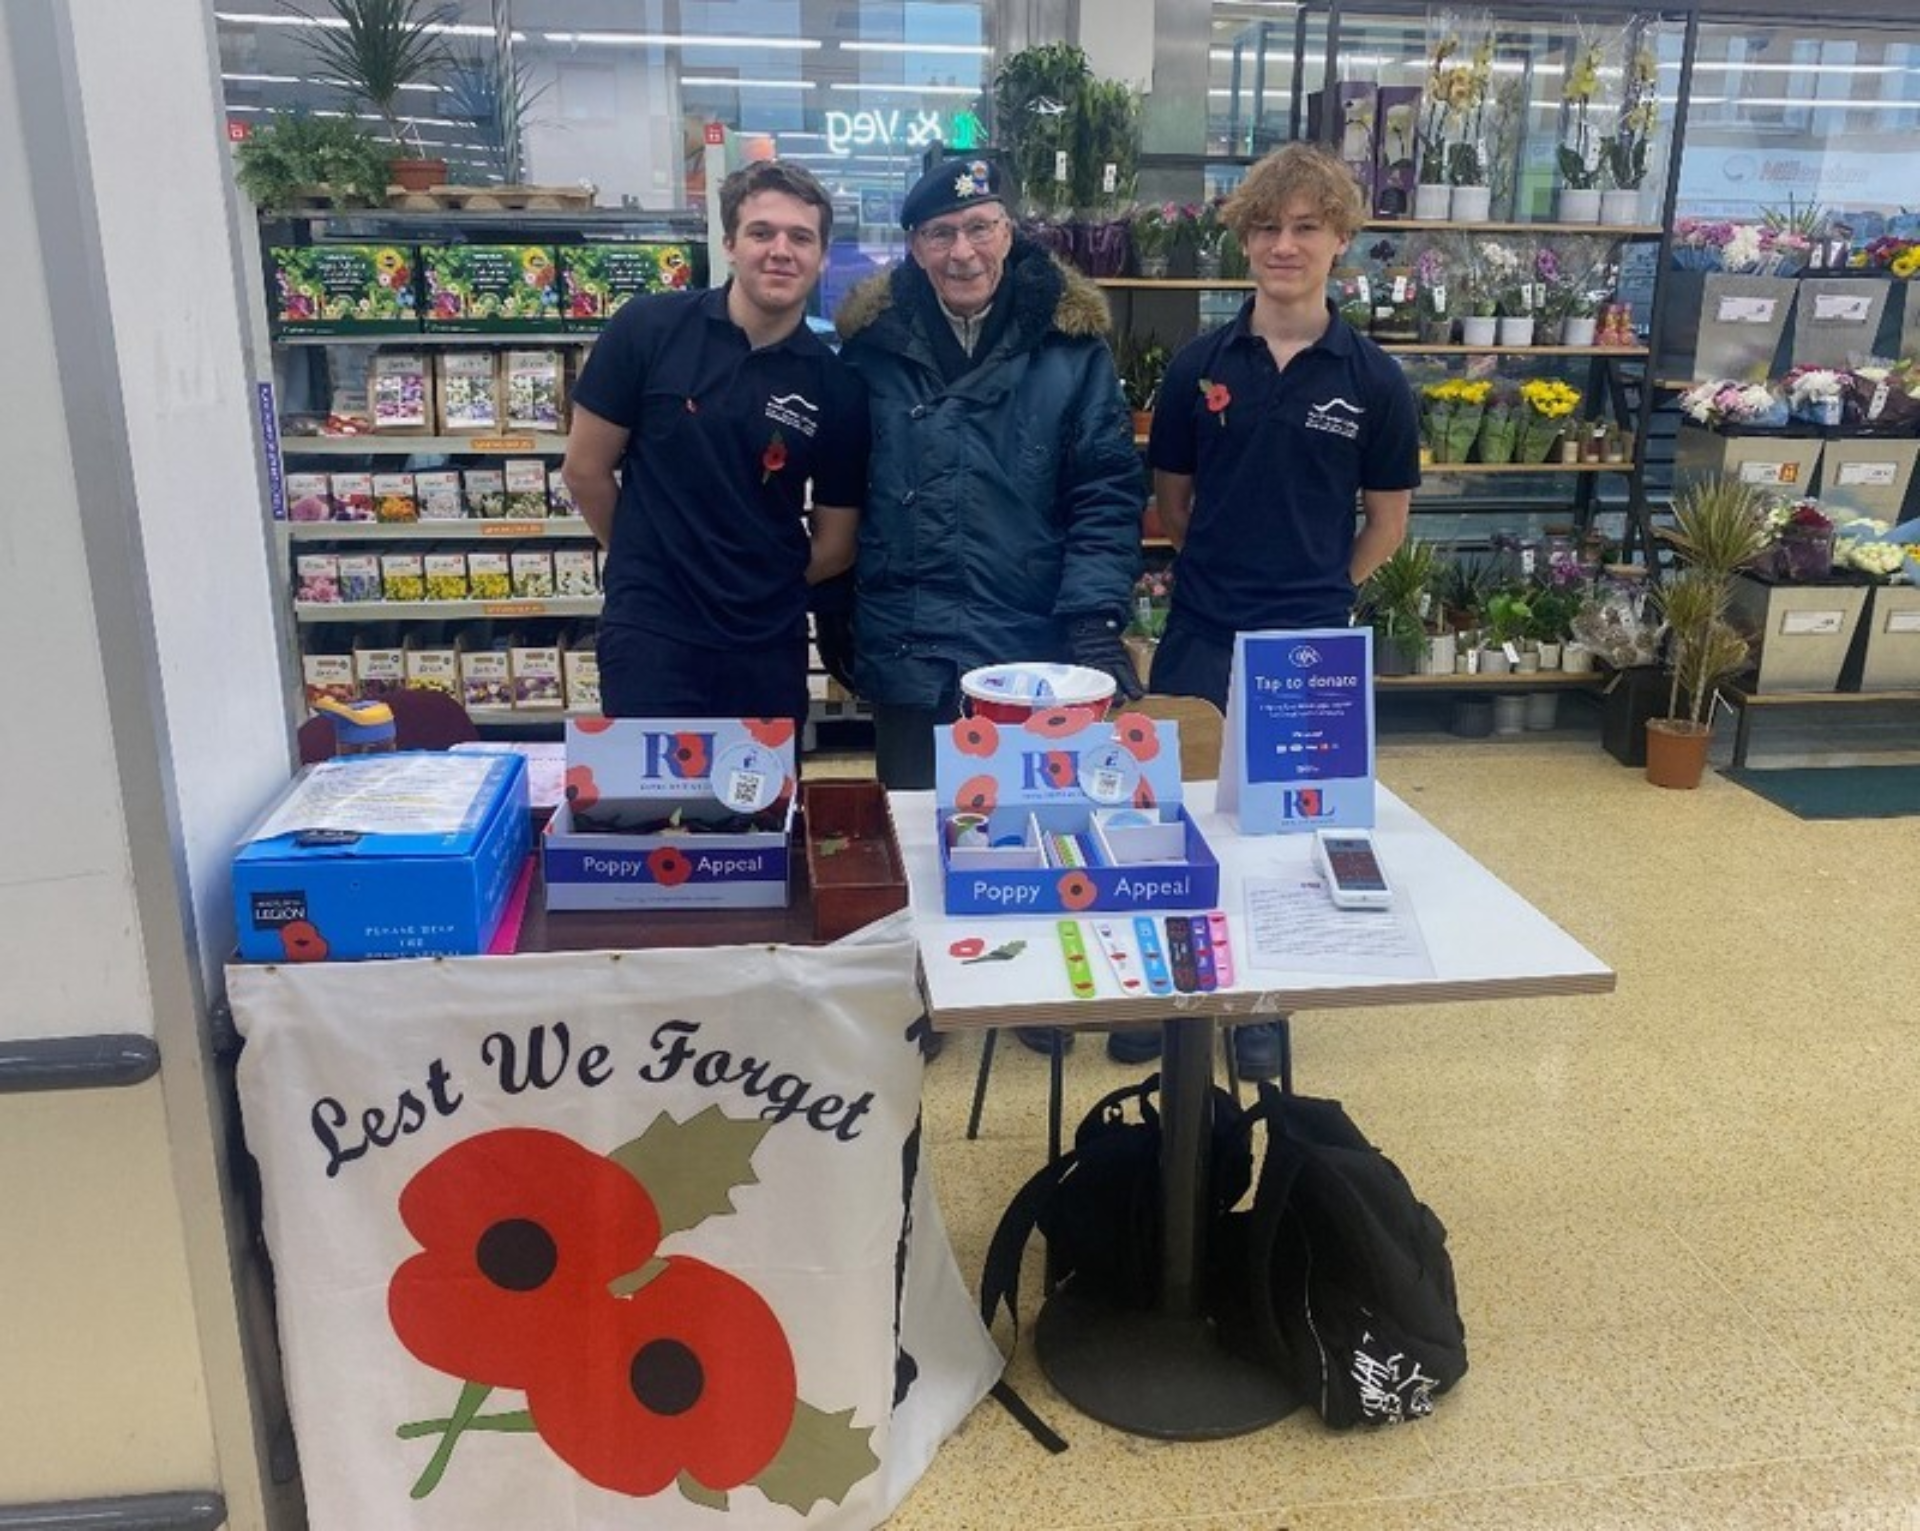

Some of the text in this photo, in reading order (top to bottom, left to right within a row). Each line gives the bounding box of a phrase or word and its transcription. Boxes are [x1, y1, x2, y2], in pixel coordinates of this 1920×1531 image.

[1254, 674, 1358, 693] Tap to donate
[583, 856, 763, 876] Poppy Appeal
[973, 876, 1191, 905] Poppy Appeal
[255, 907, 306, 920] LEGION
[310, 1018, 877, 1178] Lest We Forget
